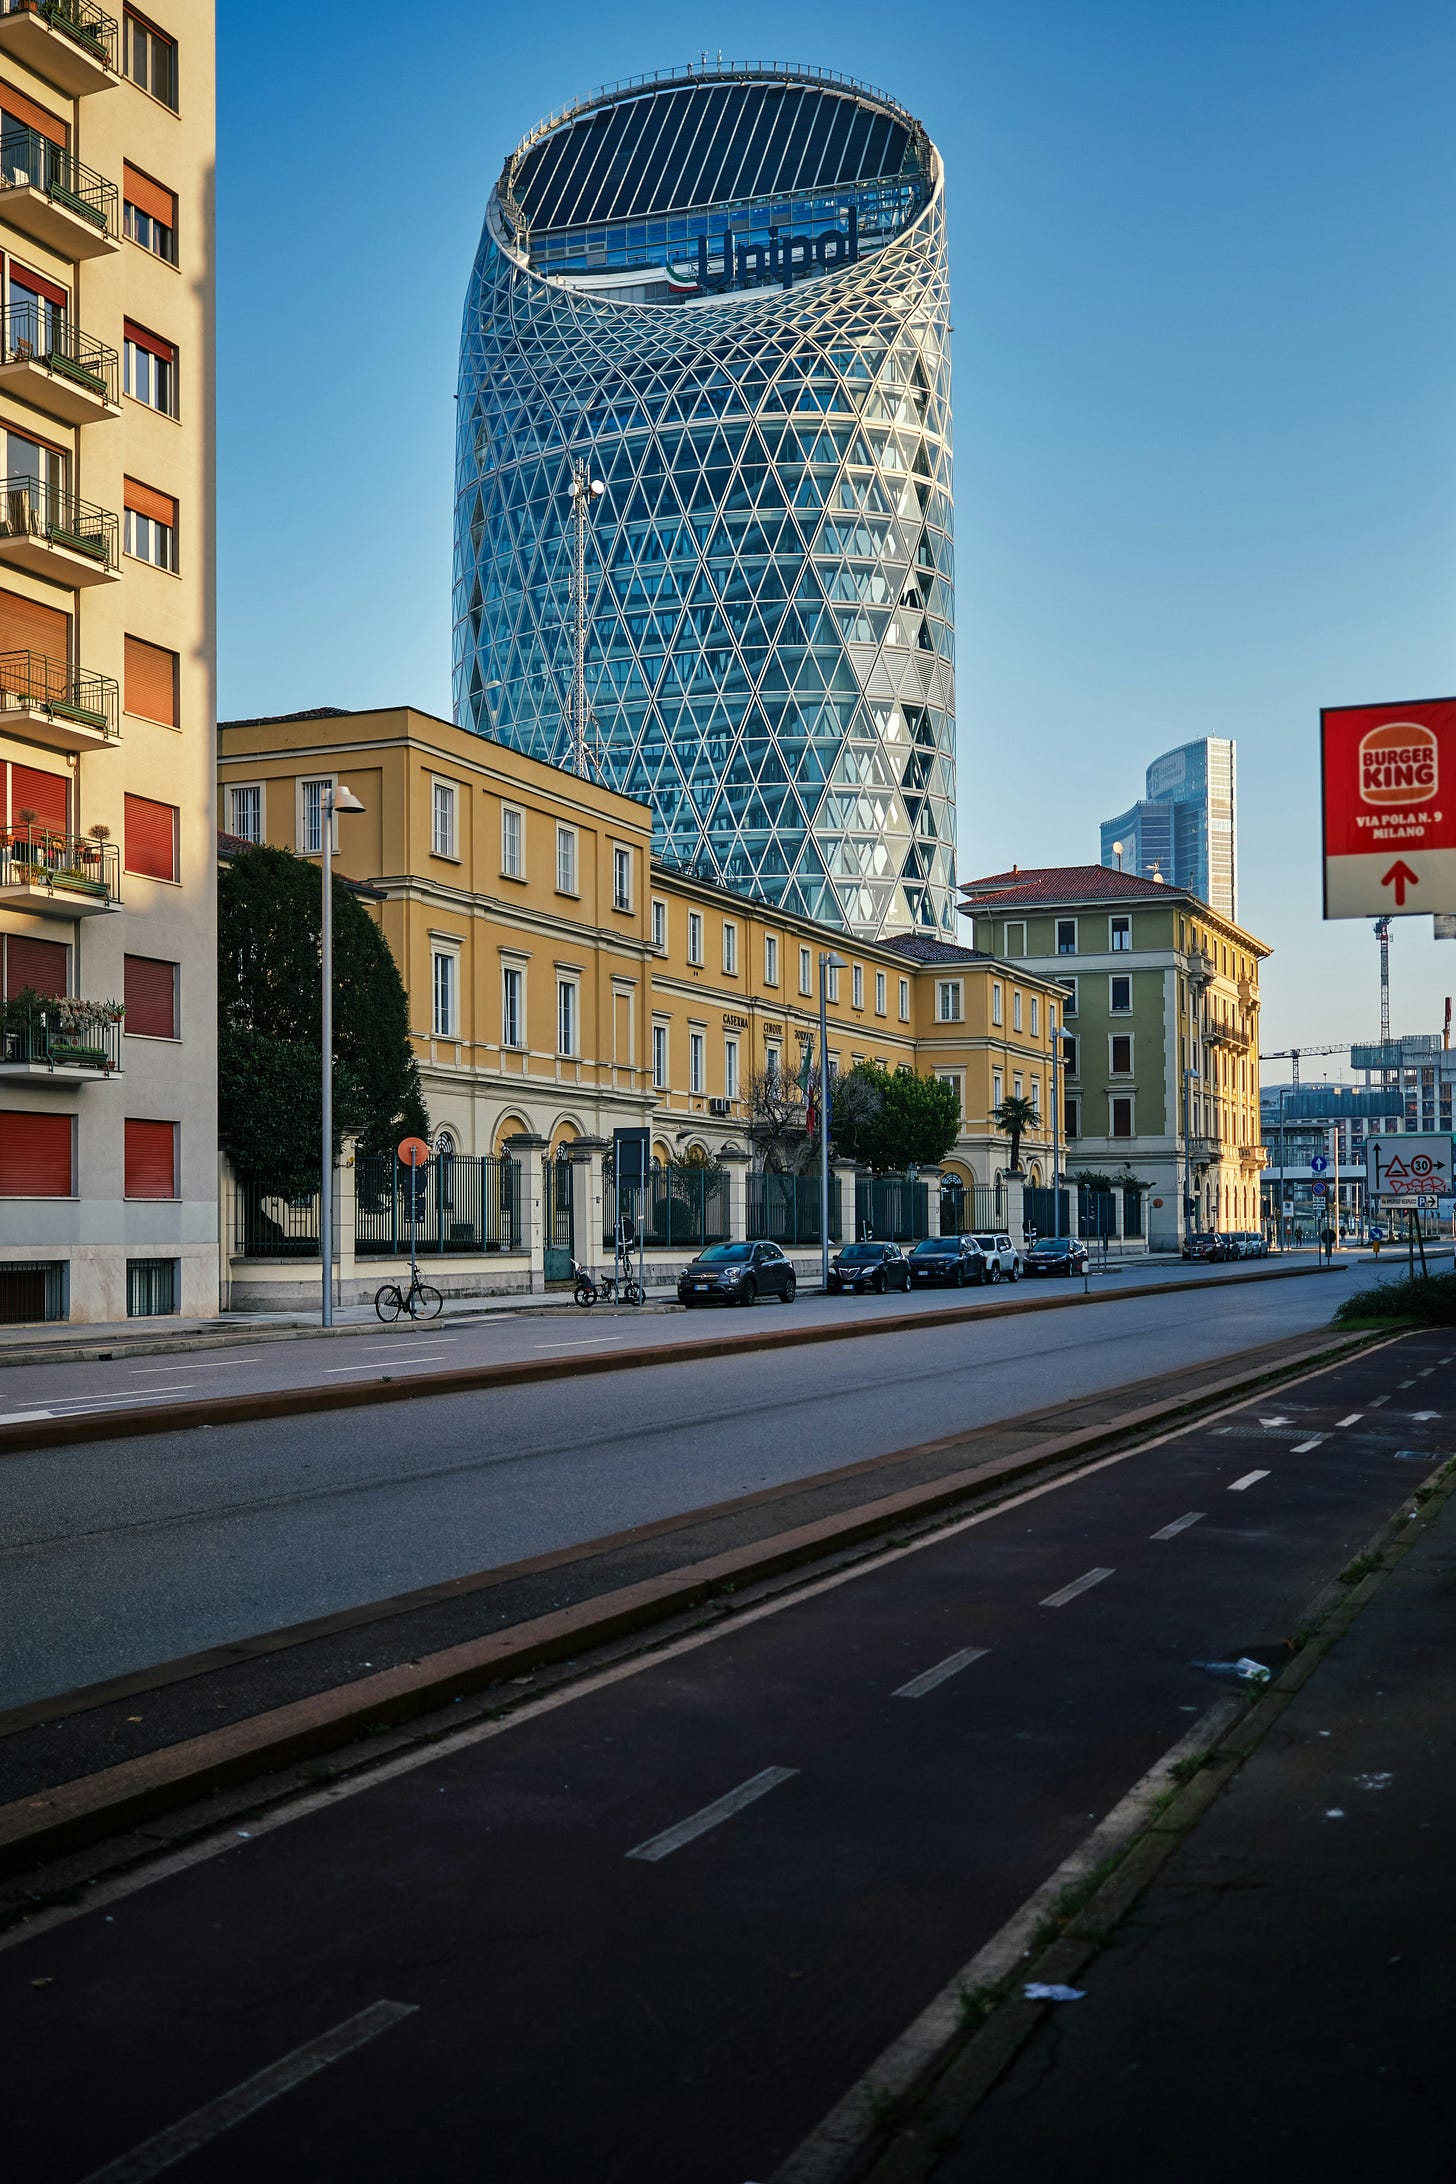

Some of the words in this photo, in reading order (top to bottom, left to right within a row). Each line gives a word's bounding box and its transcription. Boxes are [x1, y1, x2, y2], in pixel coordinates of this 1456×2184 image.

[697, 205, 858, 290] Unipol
[1363, 747, 1434, 767] BURGER
[1363, 763, 1434, 789] KING
[1356, 816, 1379, 827] VIA
[1381, 813, 1416, 824] POLA
[1418, 812, 1432, 823] N.
[1433, 811, 1443, 822] 9
[1373, 826, 1425, 839] MILANO
[723, 1014, 748, 1029] CASERMA
[763, 1022, 783, 1035] CINQUE
[1415, 1160, 1428, 1171] 30
